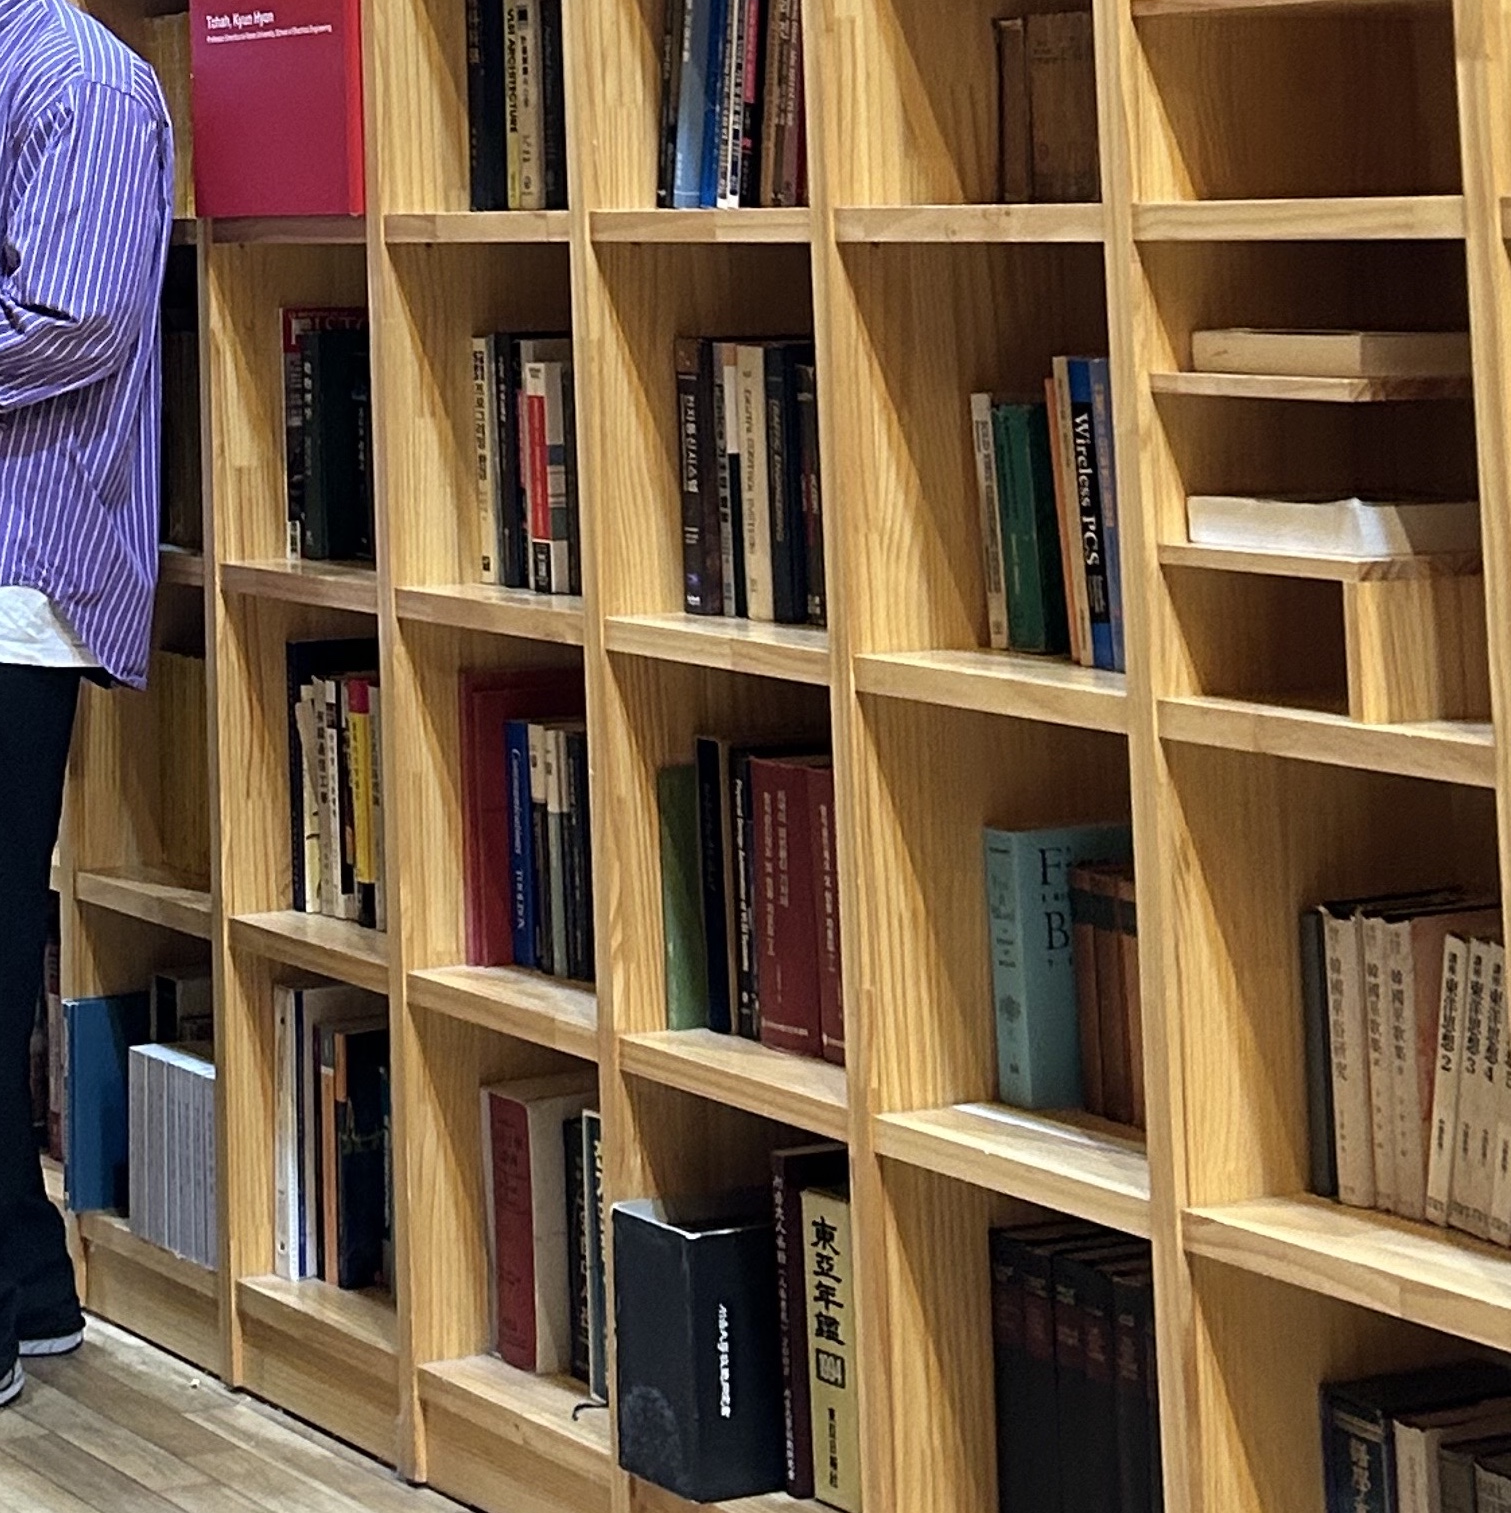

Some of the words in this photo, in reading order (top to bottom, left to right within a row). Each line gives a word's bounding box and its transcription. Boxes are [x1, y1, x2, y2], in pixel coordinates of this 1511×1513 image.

[508, 38, 519, 133] ARCHITECTURE
[1073, 411, 1092, 508] Wireless
[1081, 514, 1100, 567] PCS
[810, 1216, 846, 1346] 東亞年鑑
